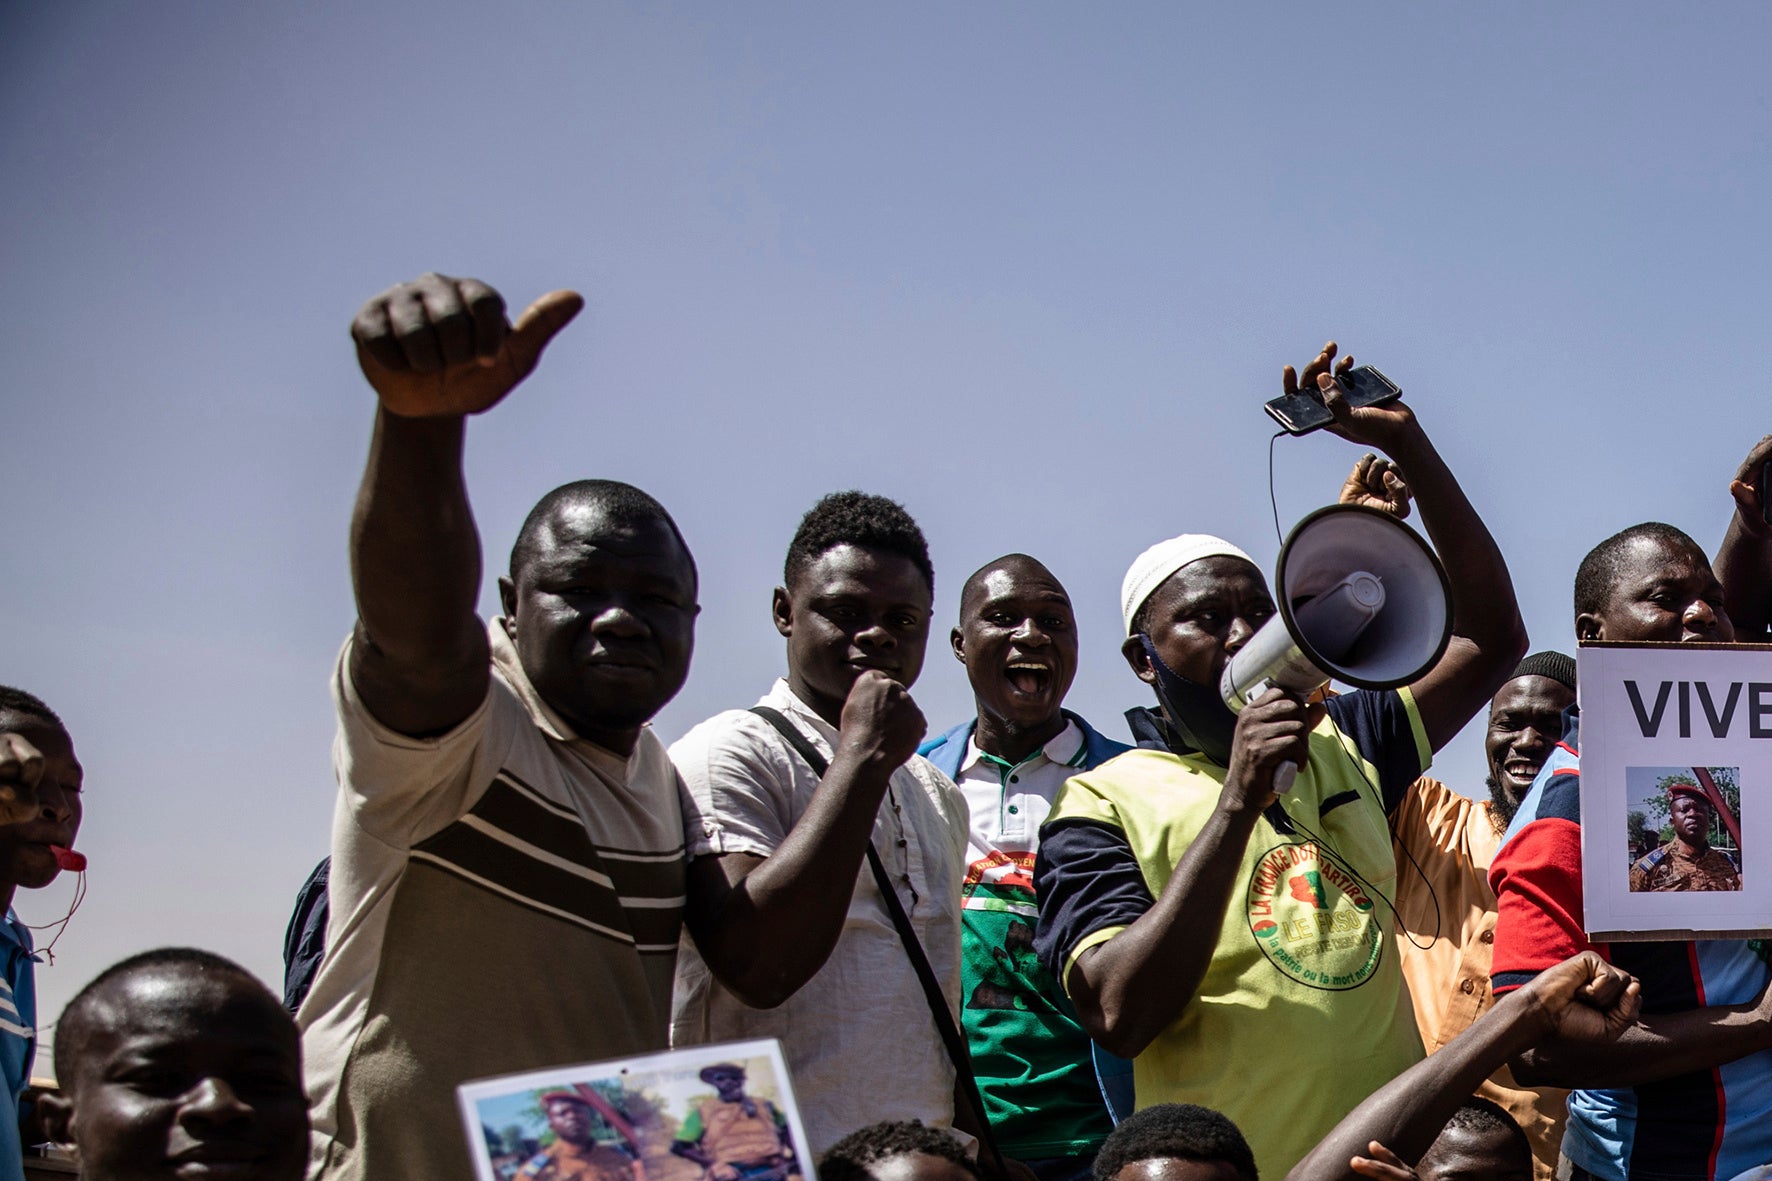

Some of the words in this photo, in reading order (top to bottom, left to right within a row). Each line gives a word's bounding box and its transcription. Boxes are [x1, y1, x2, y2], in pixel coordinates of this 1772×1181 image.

[1254, 849, 1291, 897] FRANCE
[1252, 900, 1272, 916] LA
[1282, 917, 1313, 942] LE
[1313, 909, 1362, 935] FASO
[1273, 947, 1302, 974] patrie
[1303, 969, 1317, 981] ou
[1319, 972, 1330, 984] la
[1333, 974, 1356, 986] mort
